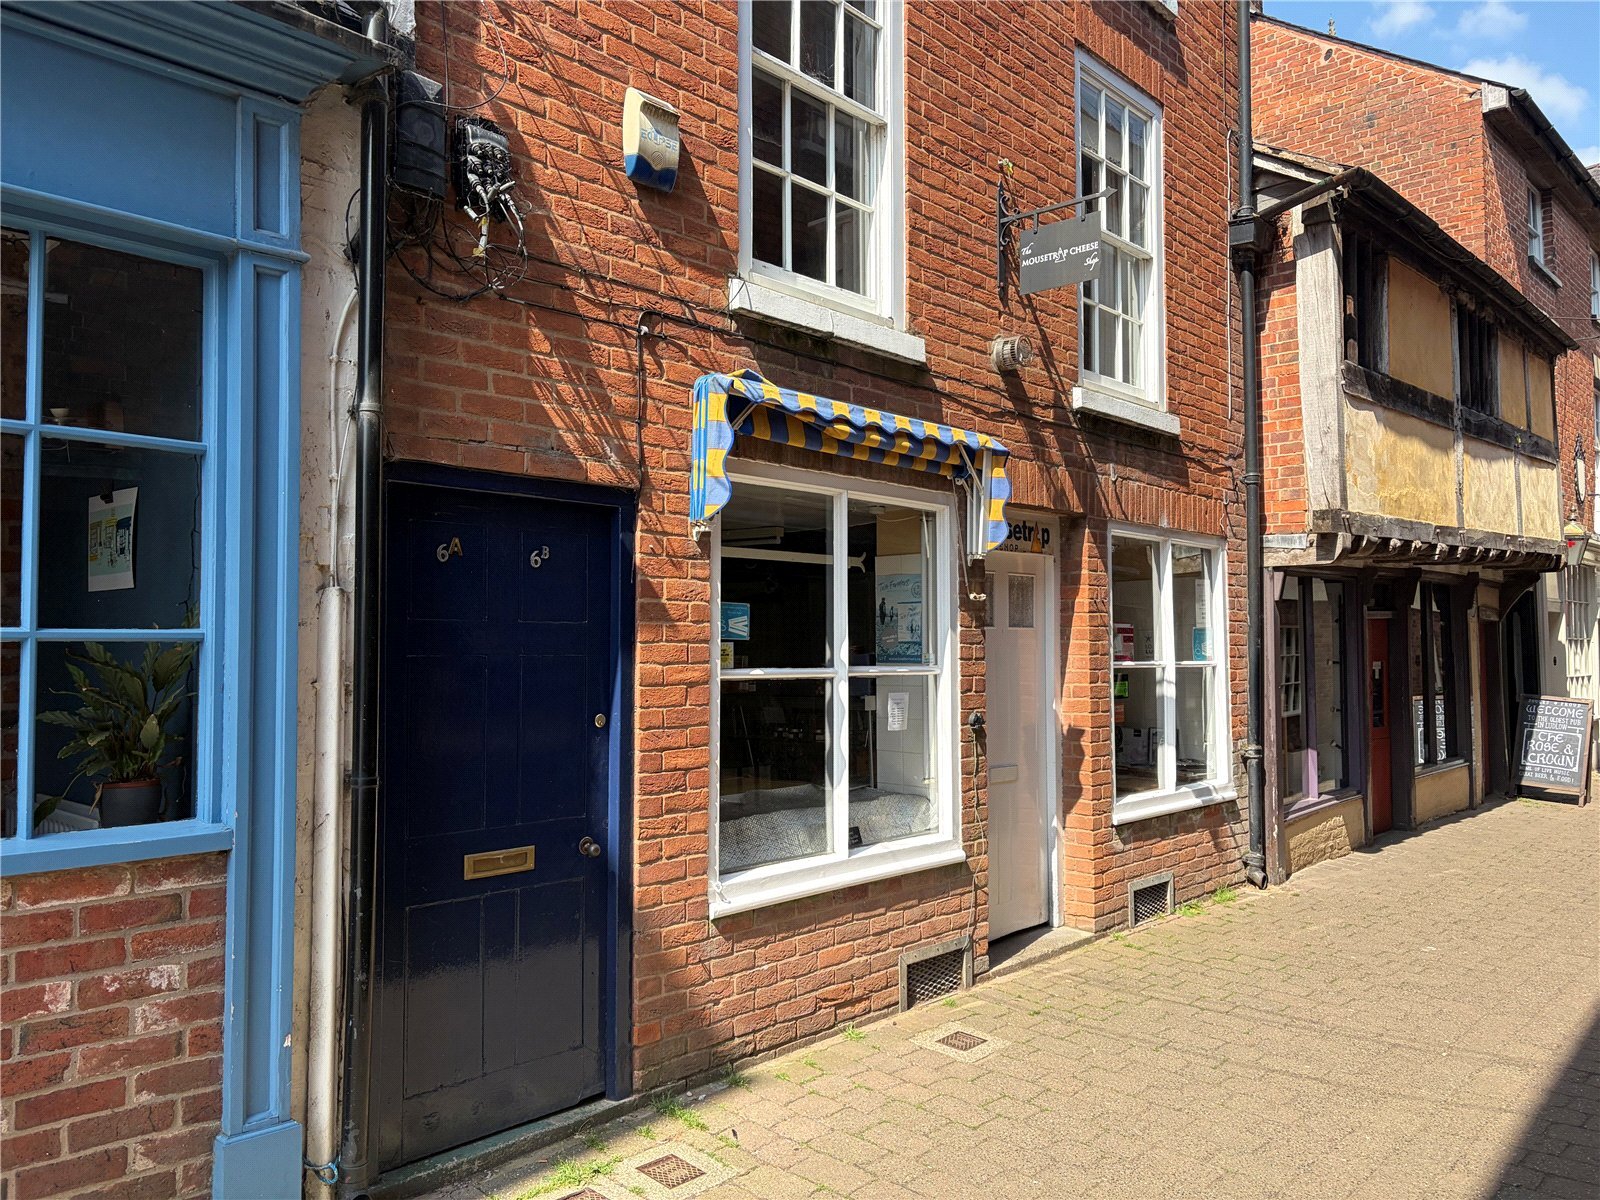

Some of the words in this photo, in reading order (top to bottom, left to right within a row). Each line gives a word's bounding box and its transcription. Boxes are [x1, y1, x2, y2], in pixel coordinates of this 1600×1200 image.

[1021, 242, 1034, 256] The
[1021, 246, 1069, 267] MOUSETRAP
[1069, 241, 1099, 255] CHEESE
[1084, 251, 1100, 271] Shop
[436, 537, 463, 562] 6A
[530, 545, 550, 568] 6B
[1525, 704, 1584, 719] WELCOME
[1538, 715, 1549, 723] THE
[1549, 716, 1568, 724] OLDEST
[1569, 718, 1581, 726] PUB
[1545, 722, 1568, 730] LUDLOW
[1527, 740, 1560, 753] ROSE
[1563, 743, 1574, 755] &
[1528, 753, 1575, 767] CROWN
